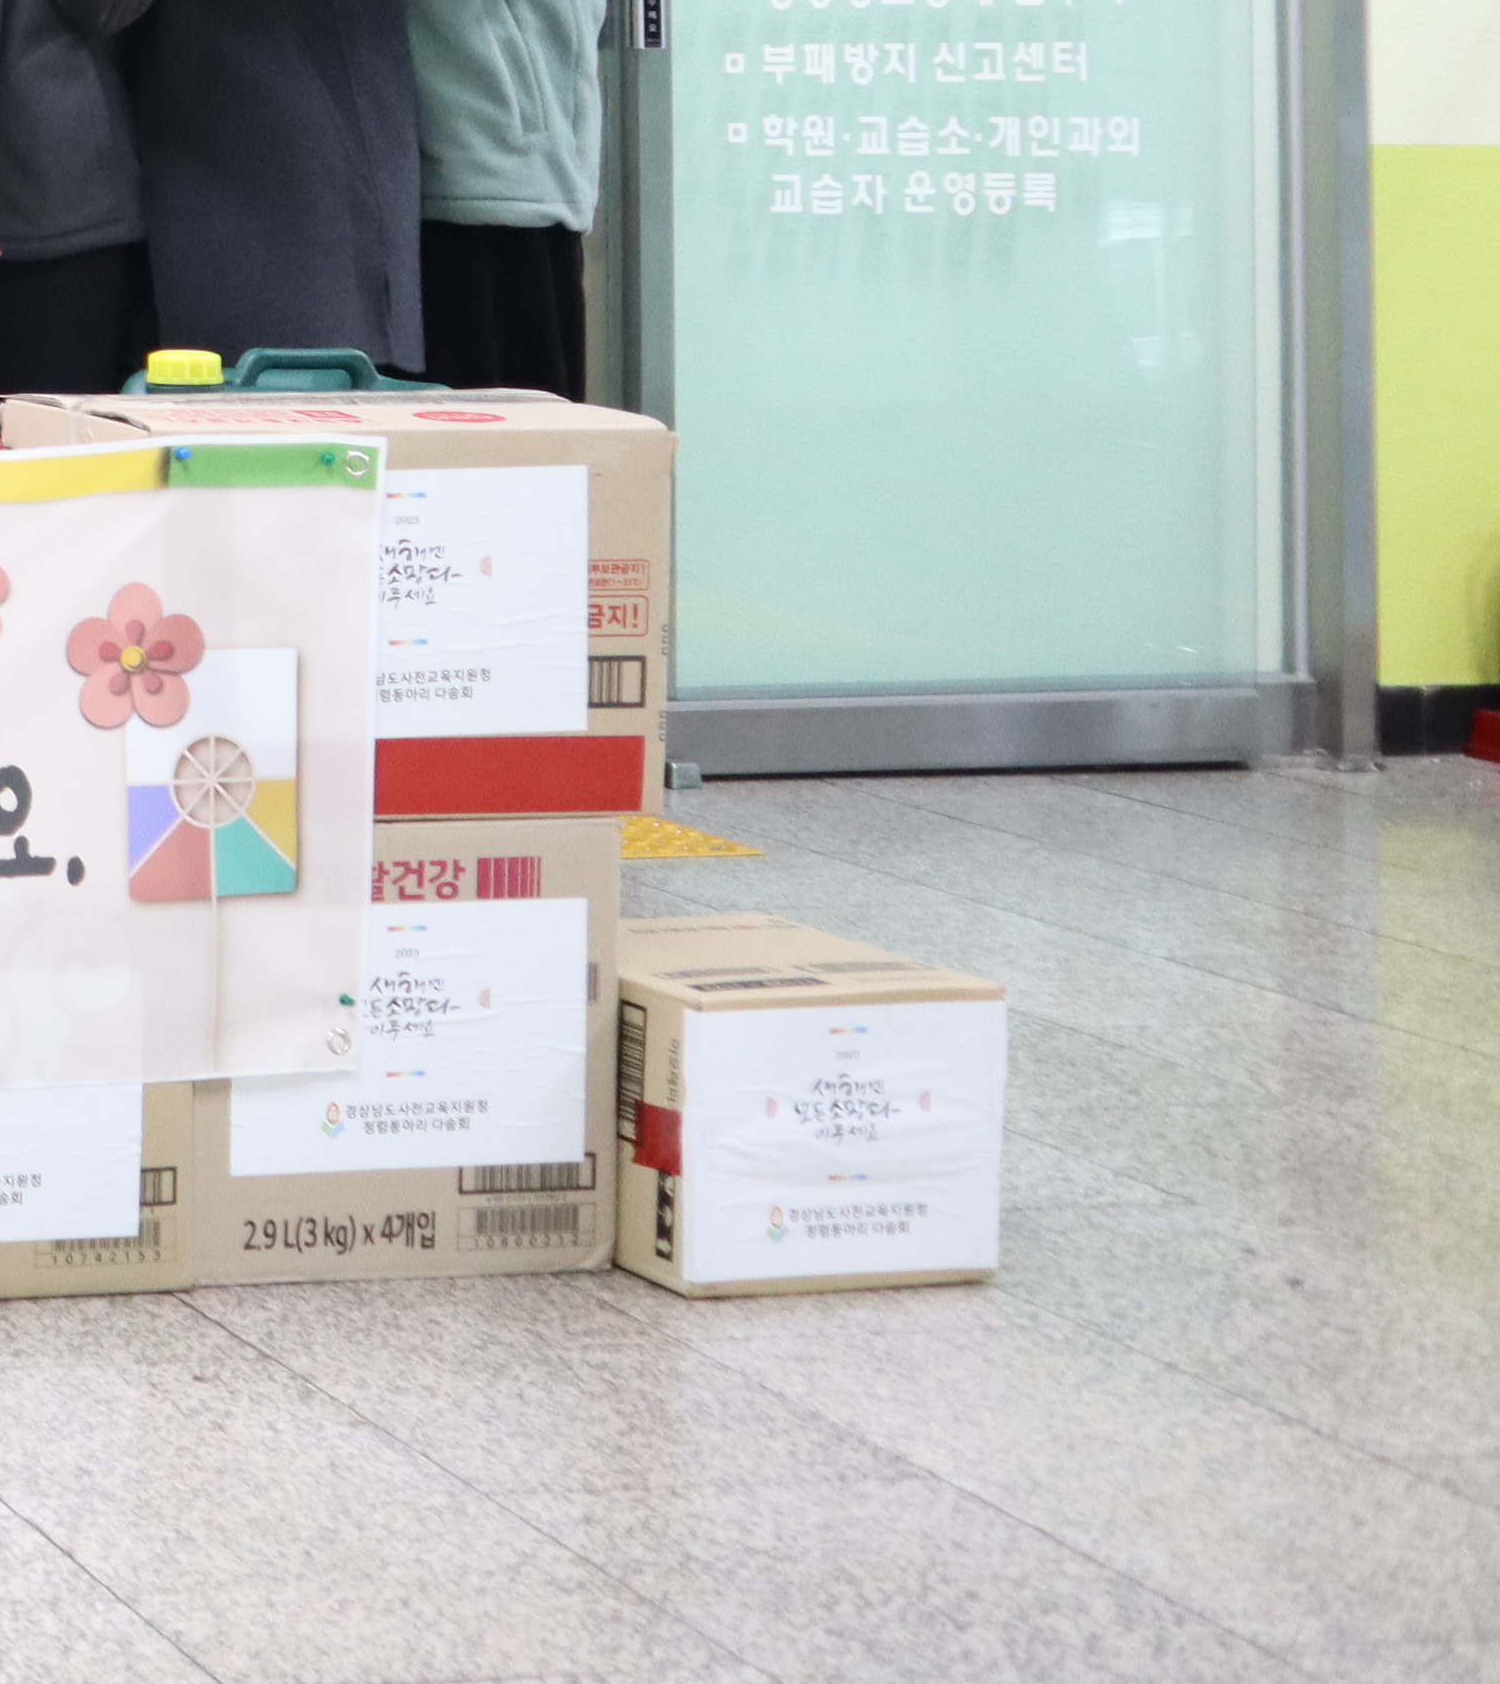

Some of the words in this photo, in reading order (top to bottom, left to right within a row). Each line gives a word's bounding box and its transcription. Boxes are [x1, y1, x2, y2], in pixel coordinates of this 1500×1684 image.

[762, 43, 917, 85] 부패방지
[932, 41, 1089, 83] 신고센터
[762, 114, 1141, 157] 학원·교습소·개인과외
[770, 173, 886, 214] 교습자
[903, 170, 1058, 216] 운영등록
[345, 1099, 489, 1119] 경상남도사천교육지원청
[362, 1118, 428, 1135] 청렴동아리
[432, 1117, 471, 1132] 다솜회
[324, 1214, 356, 1256] kg)
[380, 1211, 436, 1249] 4개입
[52, 1249, 162, 1266] 10742153
